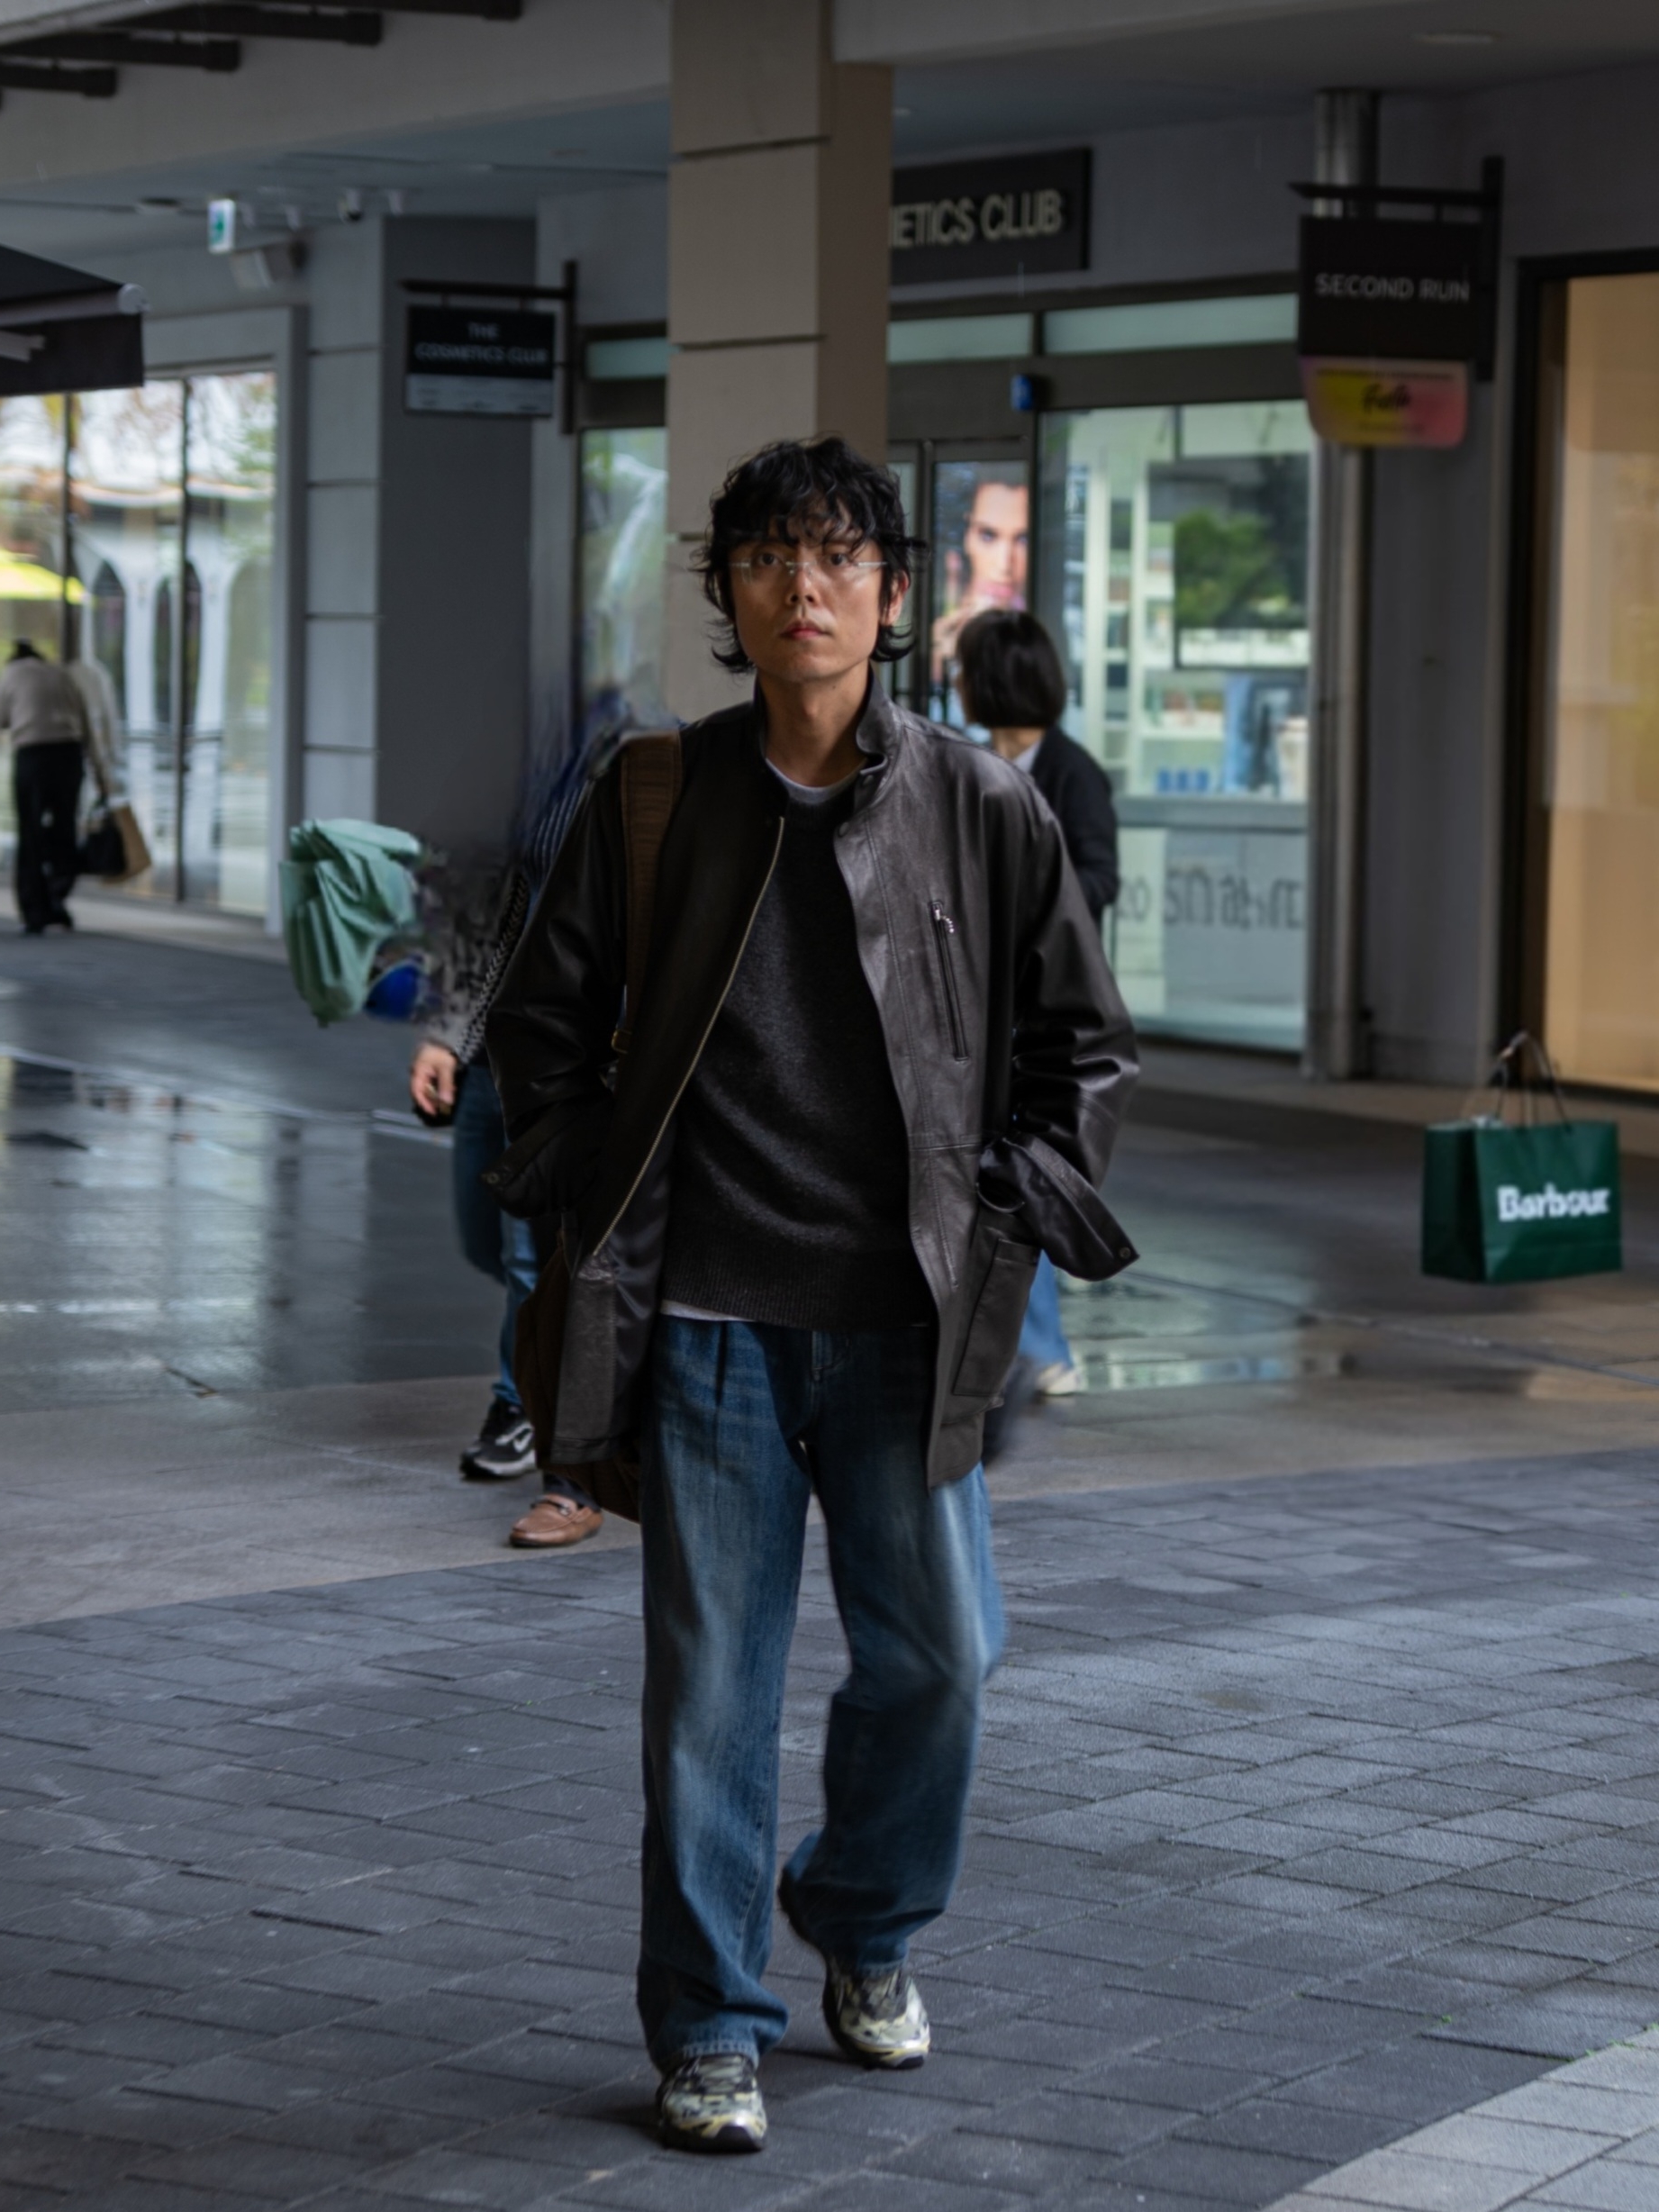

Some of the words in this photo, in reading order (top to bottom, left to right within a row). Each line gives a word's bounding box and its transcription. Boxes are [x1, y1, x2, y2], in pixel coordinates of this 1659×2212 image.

[890, 197, 974, 249] ETICS
[981, 188, 1062, 240] CLUB
[1315, 273, 1414, 298] SECOND
[1419, 278, 1470, 301] RUN
[467, 322, 500, 340] THE
[1497, 1183, 1609, 1221] Barbour
